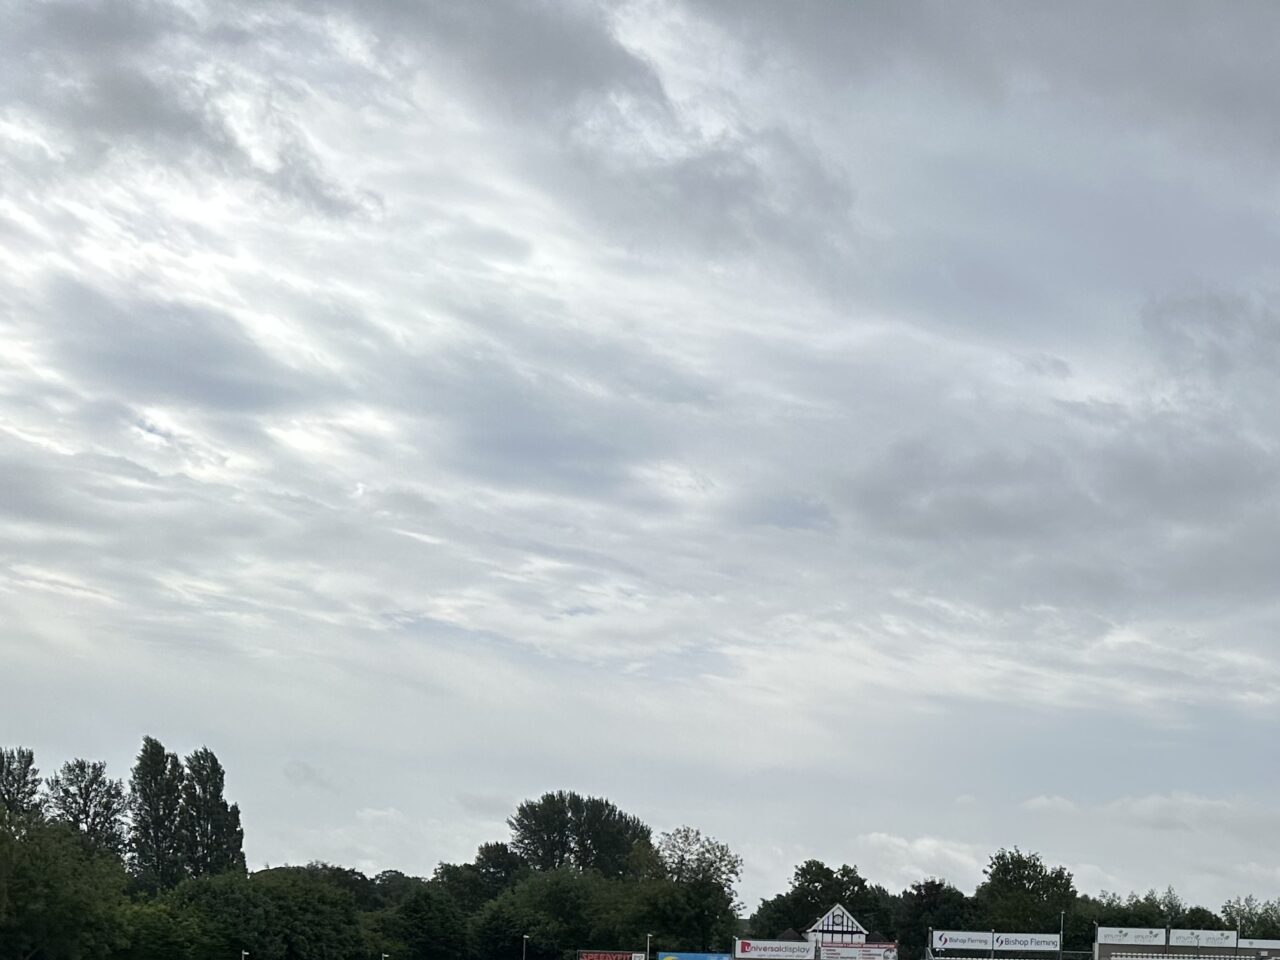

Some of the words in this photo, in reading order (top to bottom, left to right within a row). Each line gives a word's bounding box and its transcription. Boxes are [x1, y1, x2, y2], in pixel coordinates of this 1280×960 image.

[949, 937, 967, 945] Bishop
[967, 937, 988, 946] Fleming
[1005, 938, 1029, 948] Bishop
[1030, 938, 1058, 949] Fleming
